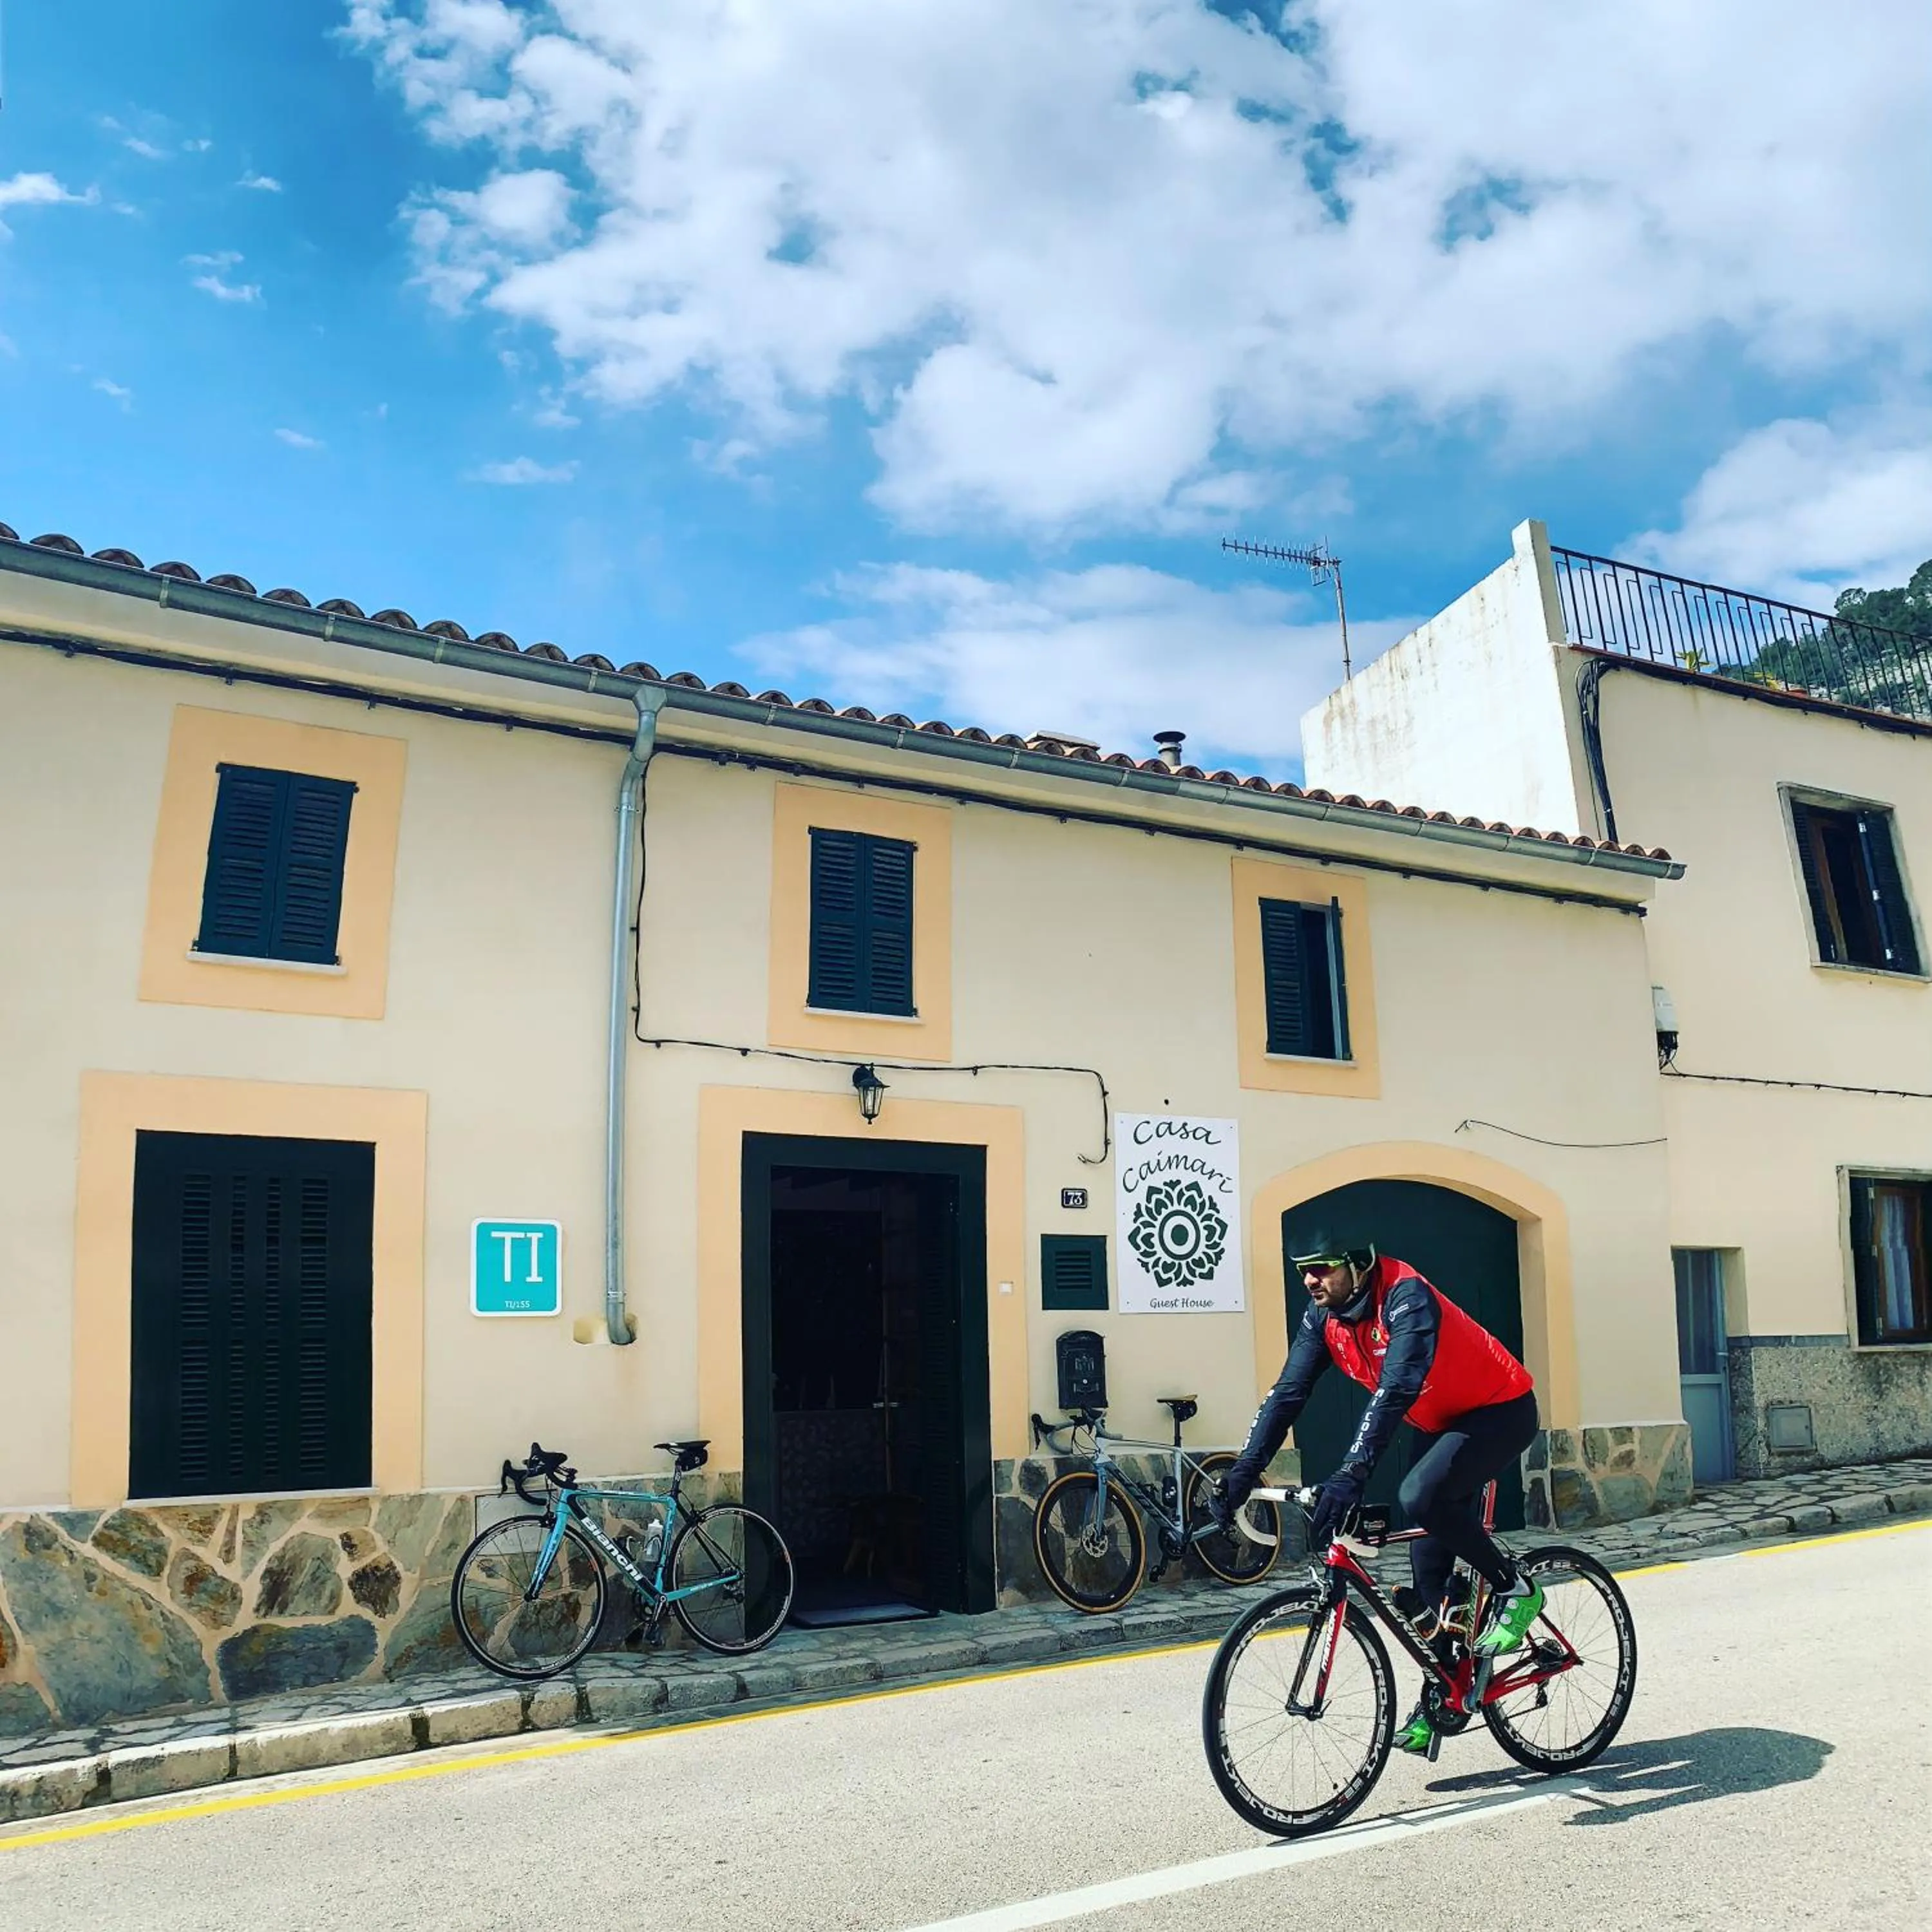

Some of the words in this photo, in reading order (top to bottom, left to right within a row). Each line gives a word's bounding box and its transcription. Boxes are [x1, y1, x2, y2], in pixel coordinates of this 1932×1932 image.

[1133, 1121, 1221, 1144] Casa
[1122, 1150, 1233, 1193] Caimari
[1067, 1192, 1083, 1205] 73
[491, 1231, 544, 1282] TI
[1150, 1298, 1180, 1309] Guest
[1181, 1298, 1215, 1308] House
[581, 1517, 644, 1581] Bianchi
[1370, 1586, 1440, 1663] MERIDA
